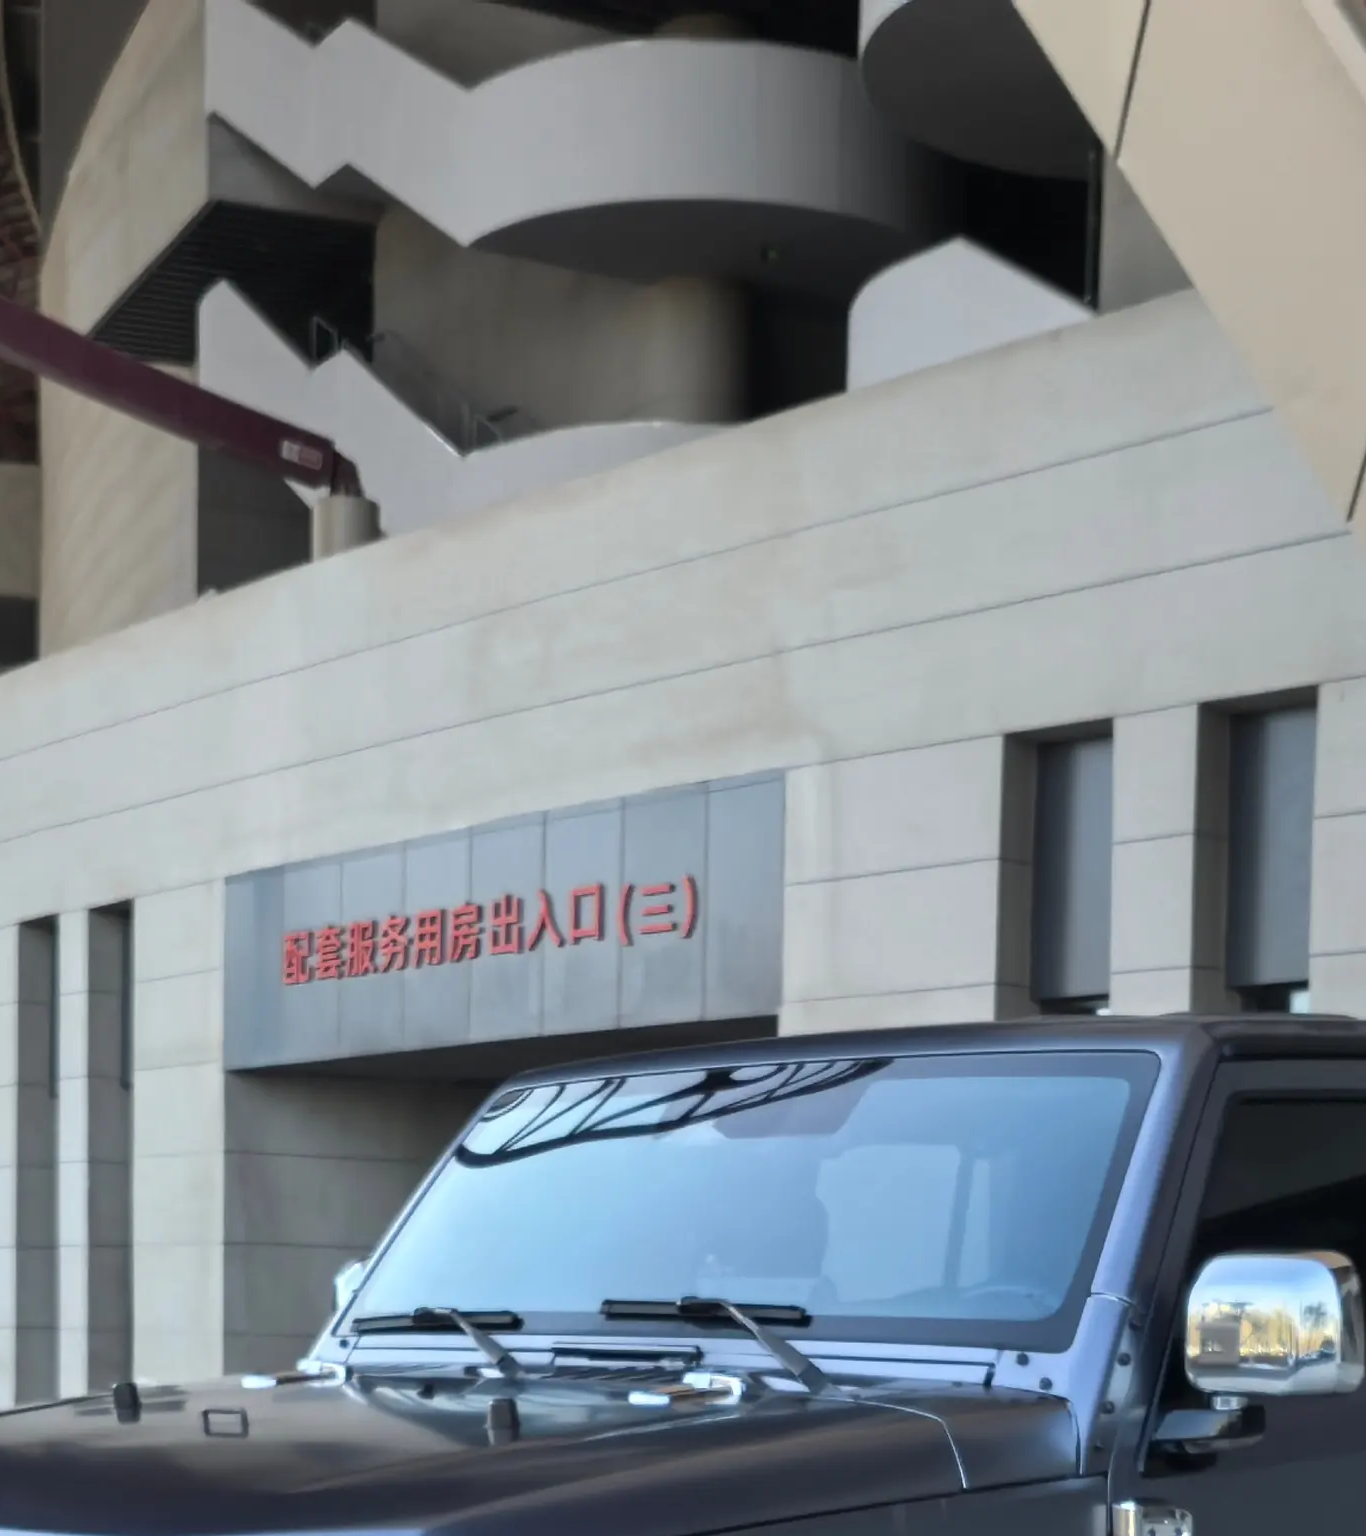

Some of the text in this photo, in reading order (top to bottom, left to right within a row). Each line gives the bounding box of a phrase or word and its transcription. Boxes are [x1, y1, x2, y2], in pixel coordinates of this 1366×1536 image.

[281, 875, 697, 986] 配套服务用房出入口(三)
